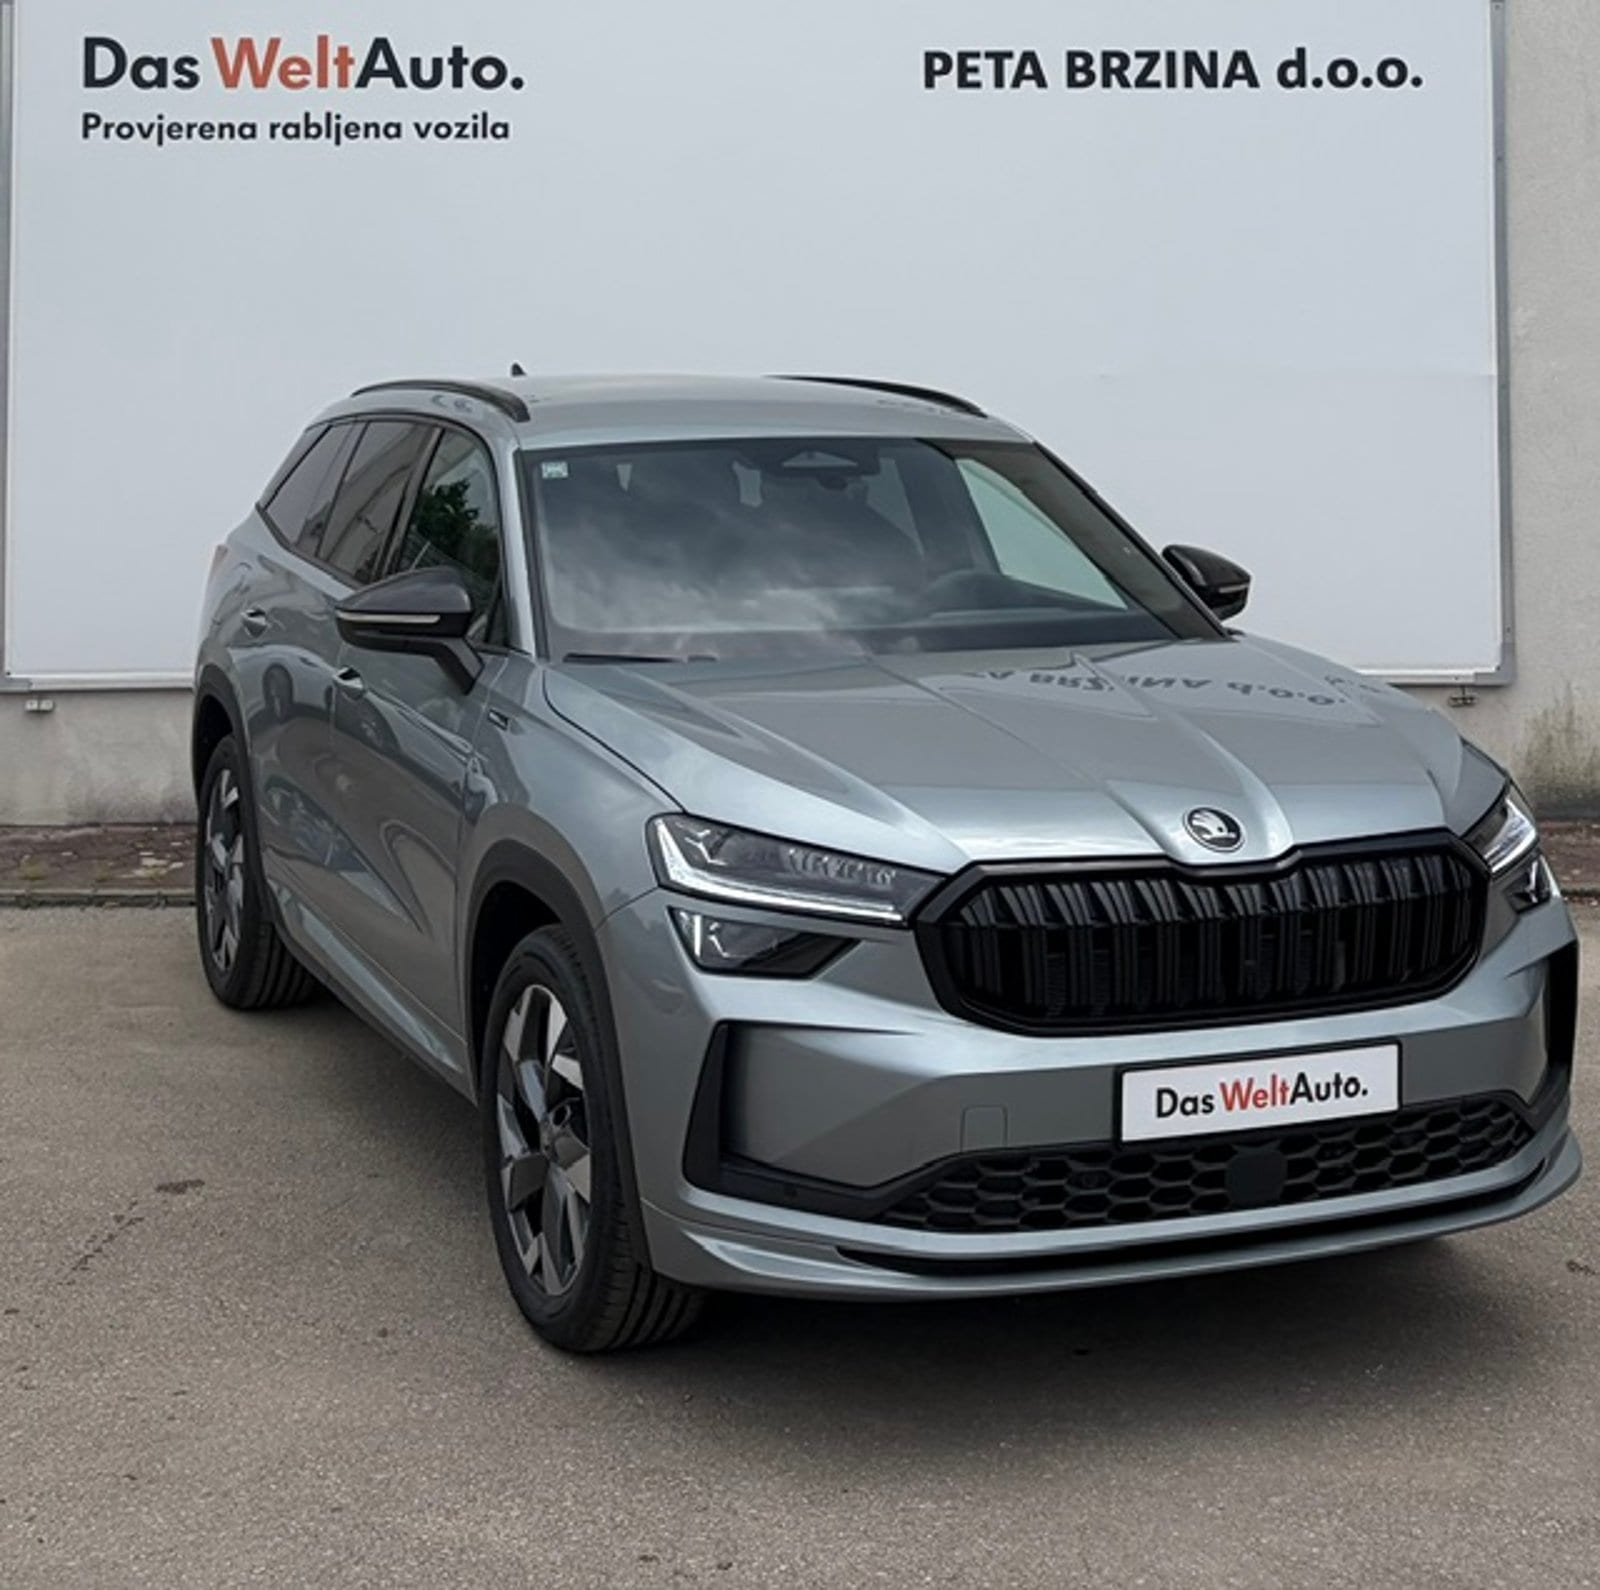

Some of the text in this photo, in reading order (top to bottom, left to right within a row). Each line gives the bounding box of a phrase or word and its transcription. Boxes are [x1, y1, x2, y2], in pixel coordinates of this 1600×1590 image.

[83, 35, 524, 90] Das WeltAuto.
[924, 47, 1423, 89] PETA BRZINA d.o.o.
[82, 111, 509, 147] Provjerena rabljena vozila
[1156, 1072, 1369, 1118] Das WeltAuto.
